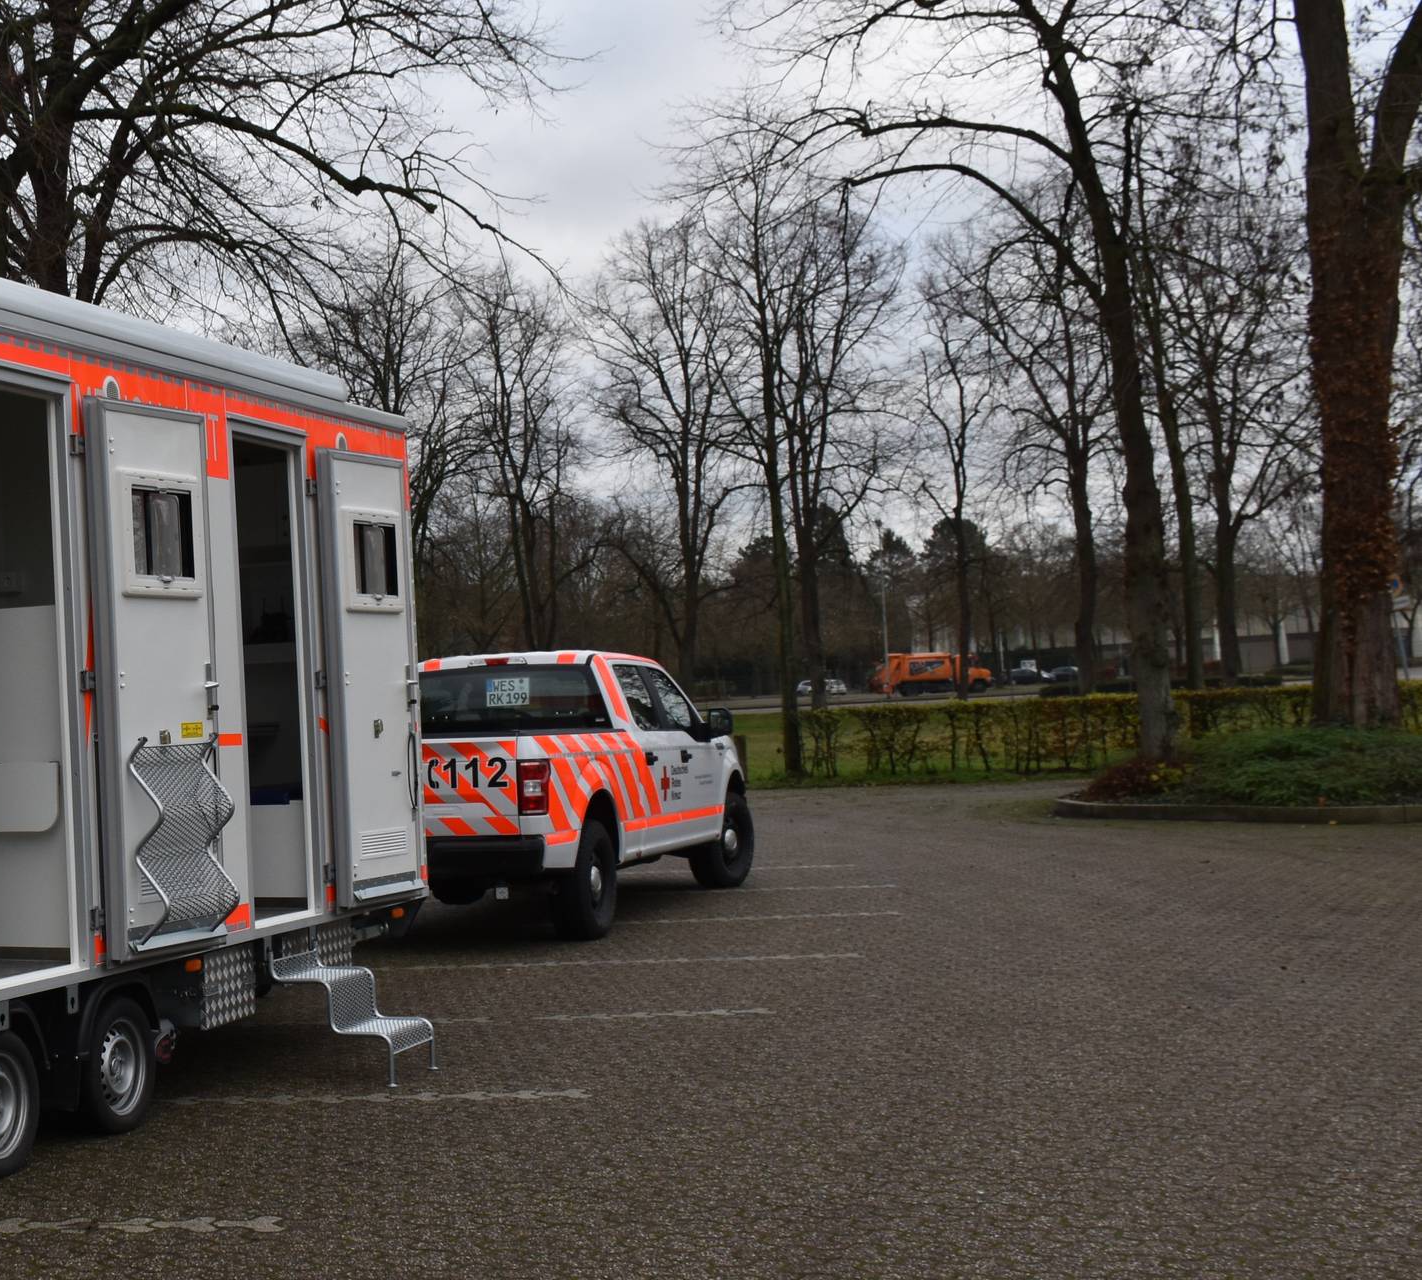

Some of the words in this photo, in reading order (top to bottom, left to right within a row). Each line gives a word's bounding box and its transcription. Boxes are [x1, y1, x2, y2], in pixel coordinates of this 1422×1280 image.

[493, 680, 515, 692] WES
[489, 692, 504, 705] RK
[506, 692, 527, 704] 199
[443, 757, 508, 788] 112
